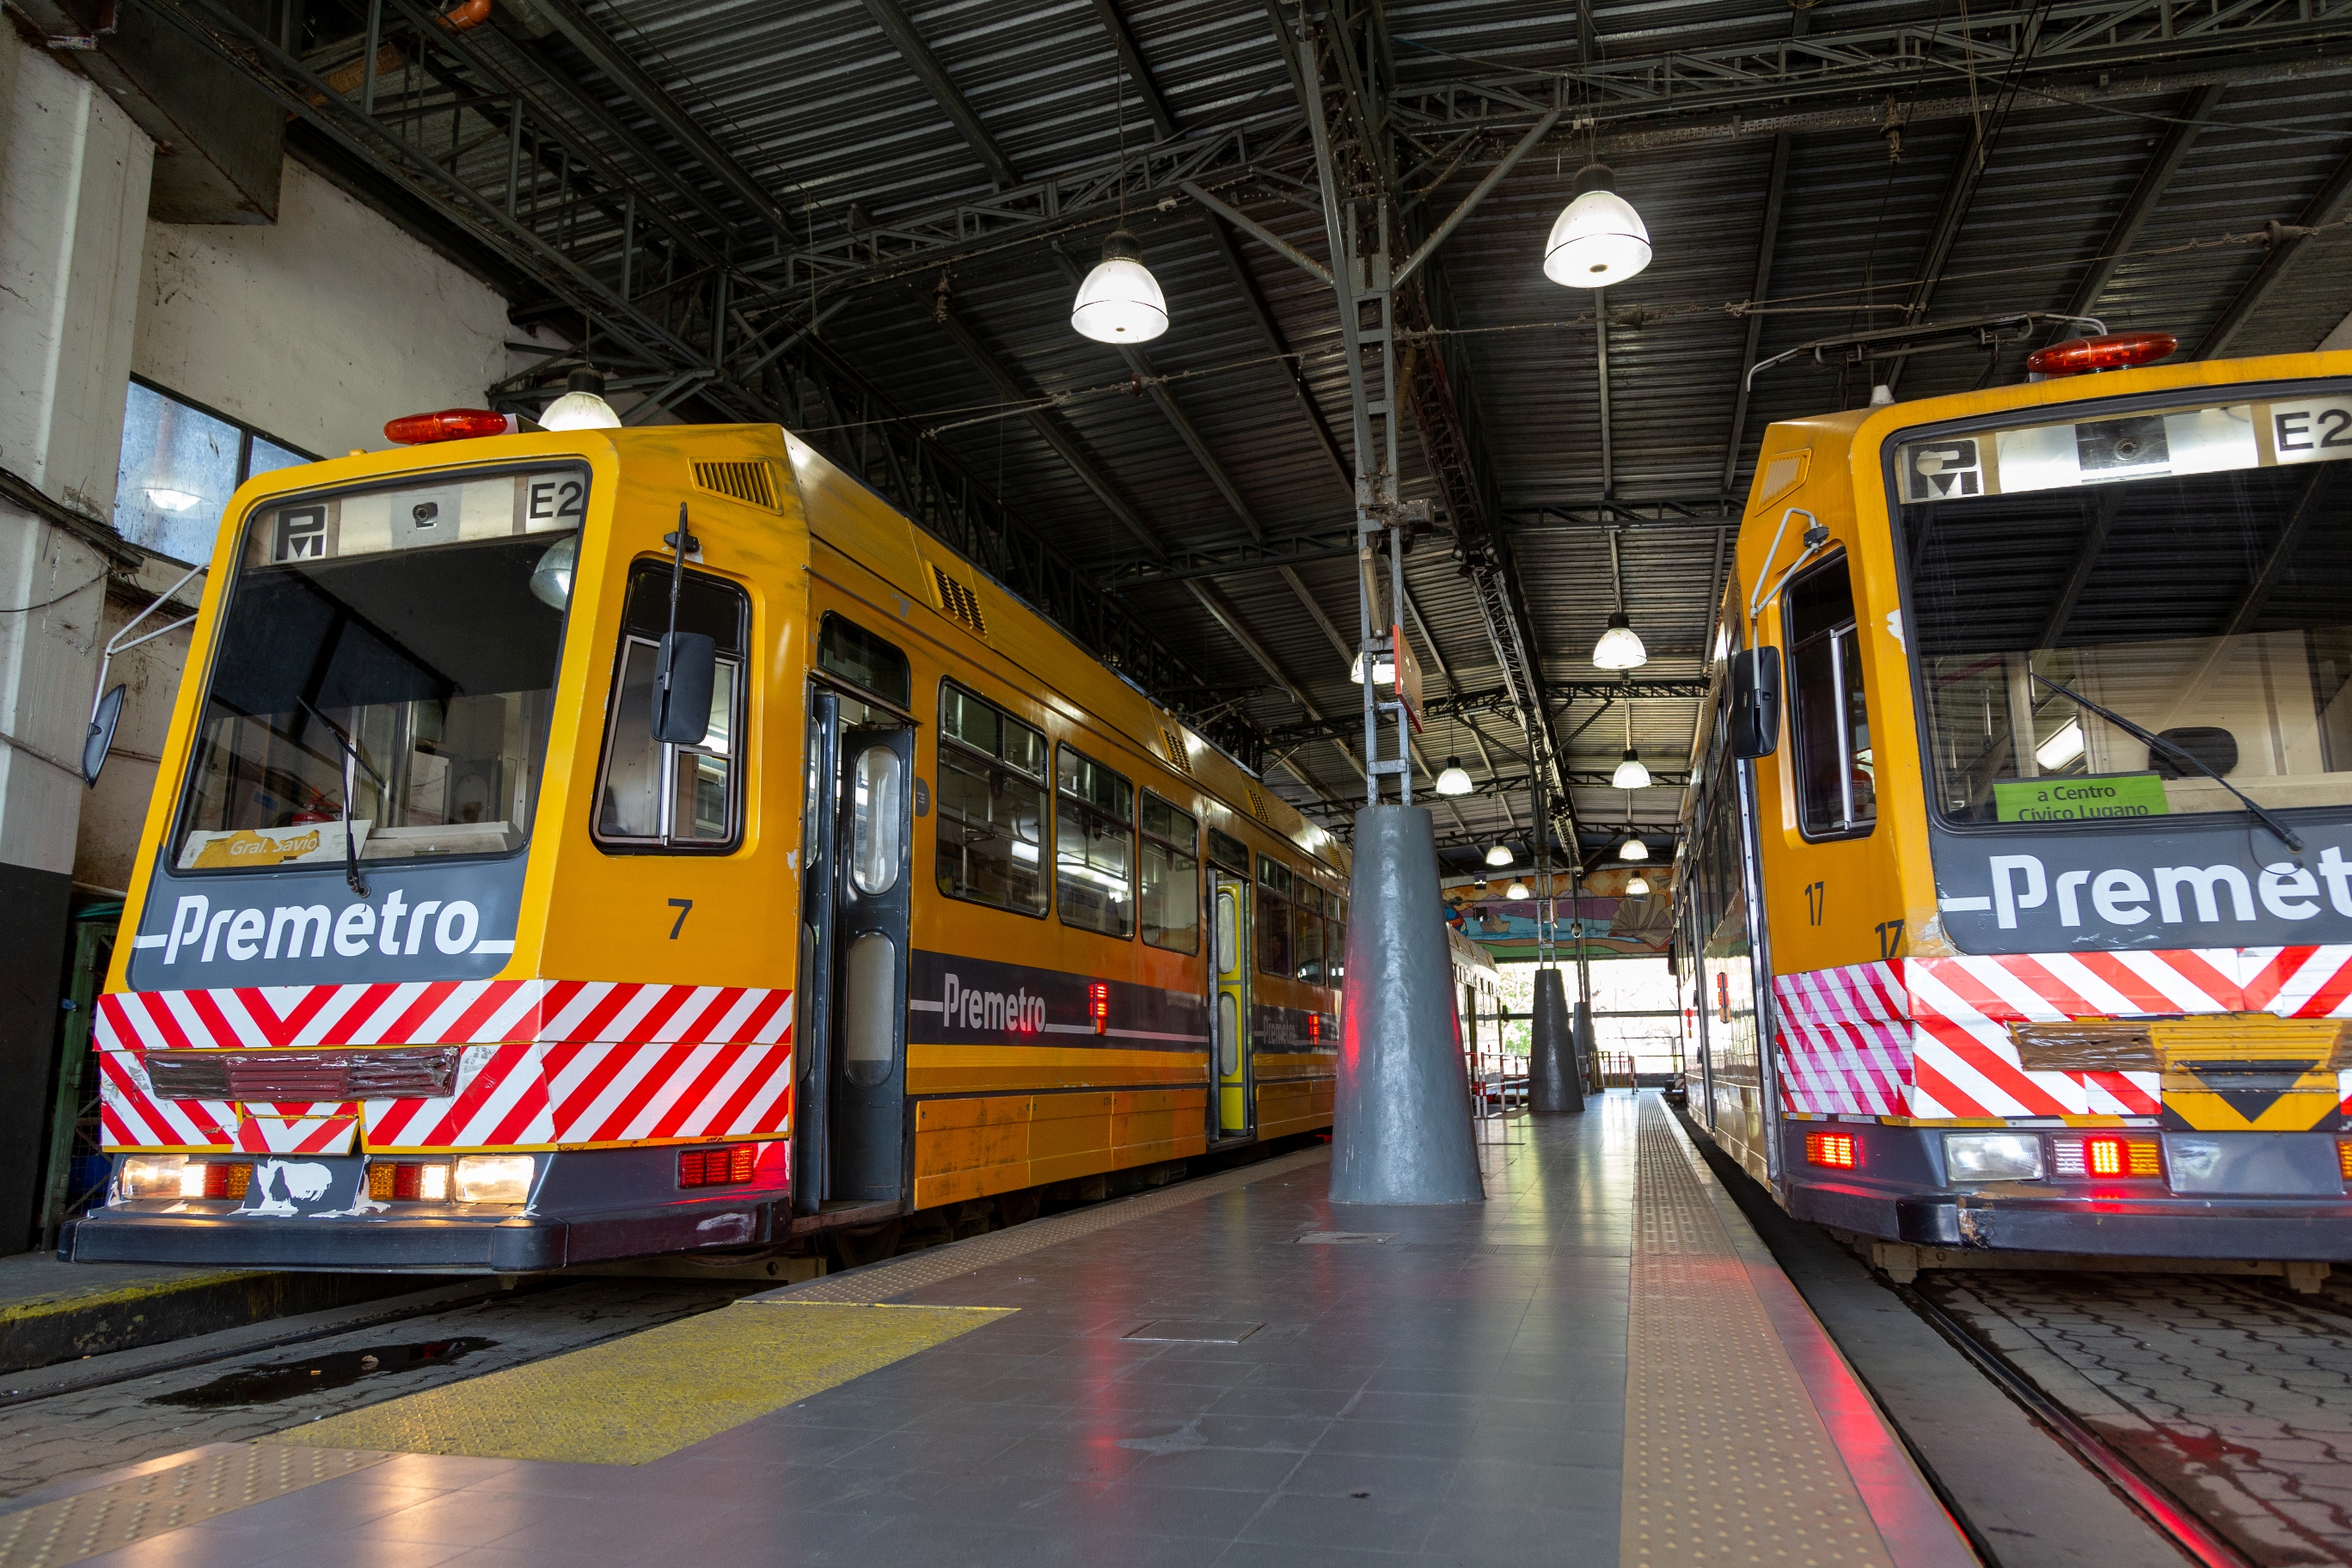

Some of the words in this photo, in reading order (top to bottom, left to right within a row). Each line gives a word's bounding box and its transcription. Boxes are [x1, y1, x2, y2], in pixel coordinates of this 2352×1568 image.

[2275, 408, 2352, 451] E2
[530, 481, 583, 519] E2
[2018, 806, 2074, 822] Cívico
[2037, 791, 2049, 802] a
[2053, 785, 2116, 801] Centro
[230, 837, 266, 855] Gral.
[273, 836, 317, 853] Savio
[668, 897, 693, 940] 7
[1804, 881, 1824, 926] 17
[163, 889, 480, 965] Premetro
[1875, 919, 1904, 958] 17
[943, 973, 1046, 1032] Premetro
